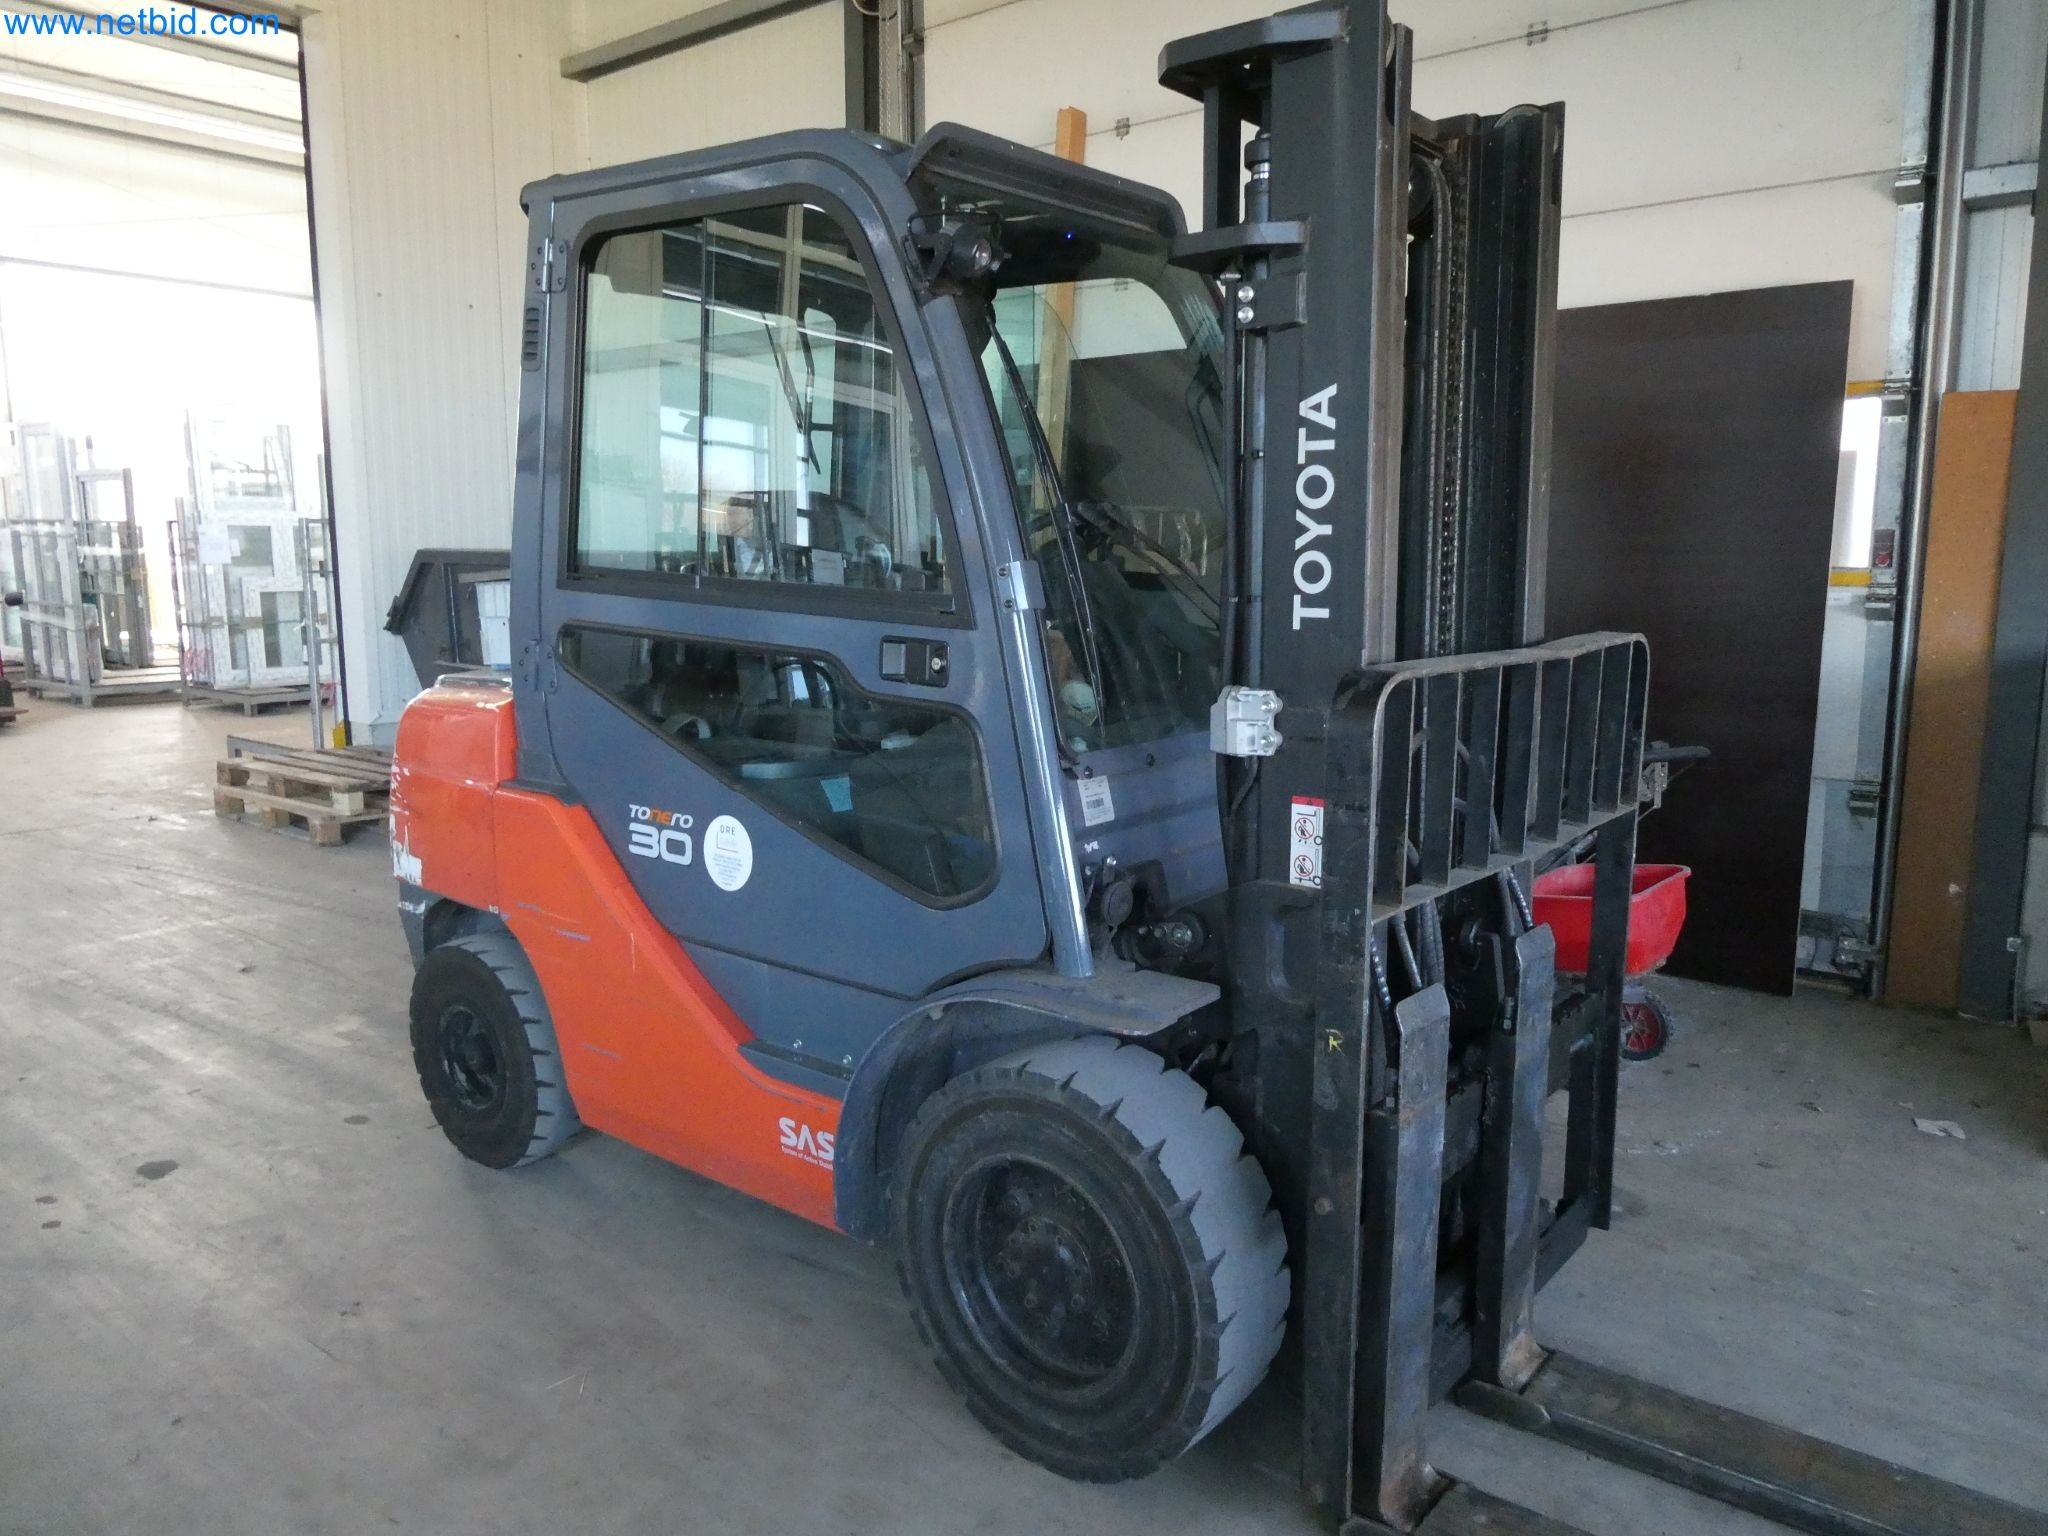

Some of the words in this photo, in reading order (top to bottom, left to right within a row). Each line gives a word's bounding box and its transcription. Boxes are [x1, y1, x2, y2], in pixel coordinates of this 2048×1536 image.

[1293, 383, 1338, 630] TOYOTA
[629, 822, 692, 866] 30
[779, 1117, 835, 1161] SAS
